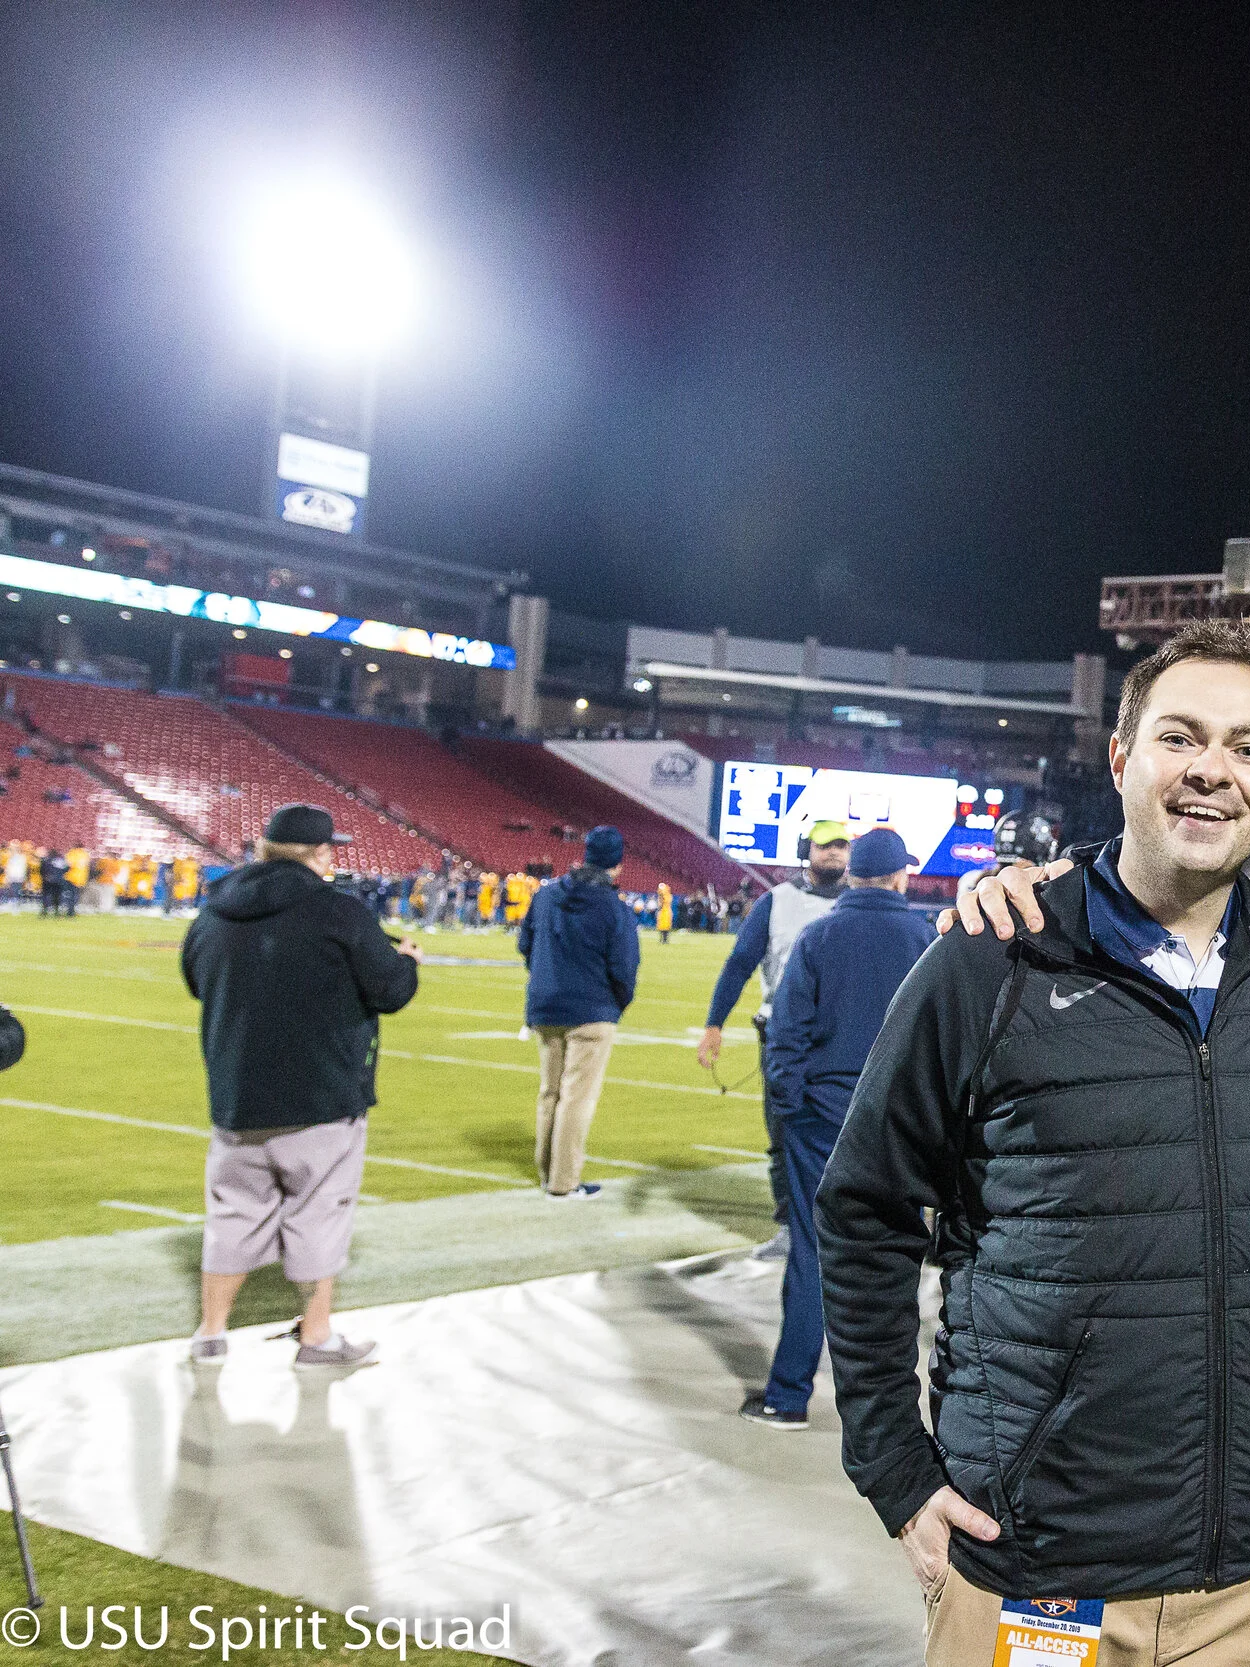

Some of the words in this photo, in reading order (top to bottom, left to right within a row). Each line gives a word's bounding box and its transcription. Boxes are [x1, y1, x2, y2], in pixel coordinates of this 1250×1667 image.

[1022, 1617, 1036, 1627] Friday,
[1037, 1619, 1060, 1629] December
[1068, 1624, 1081, 1633] 2019
[1006, 1630, 1089, 1658] ALL-ACCESS
